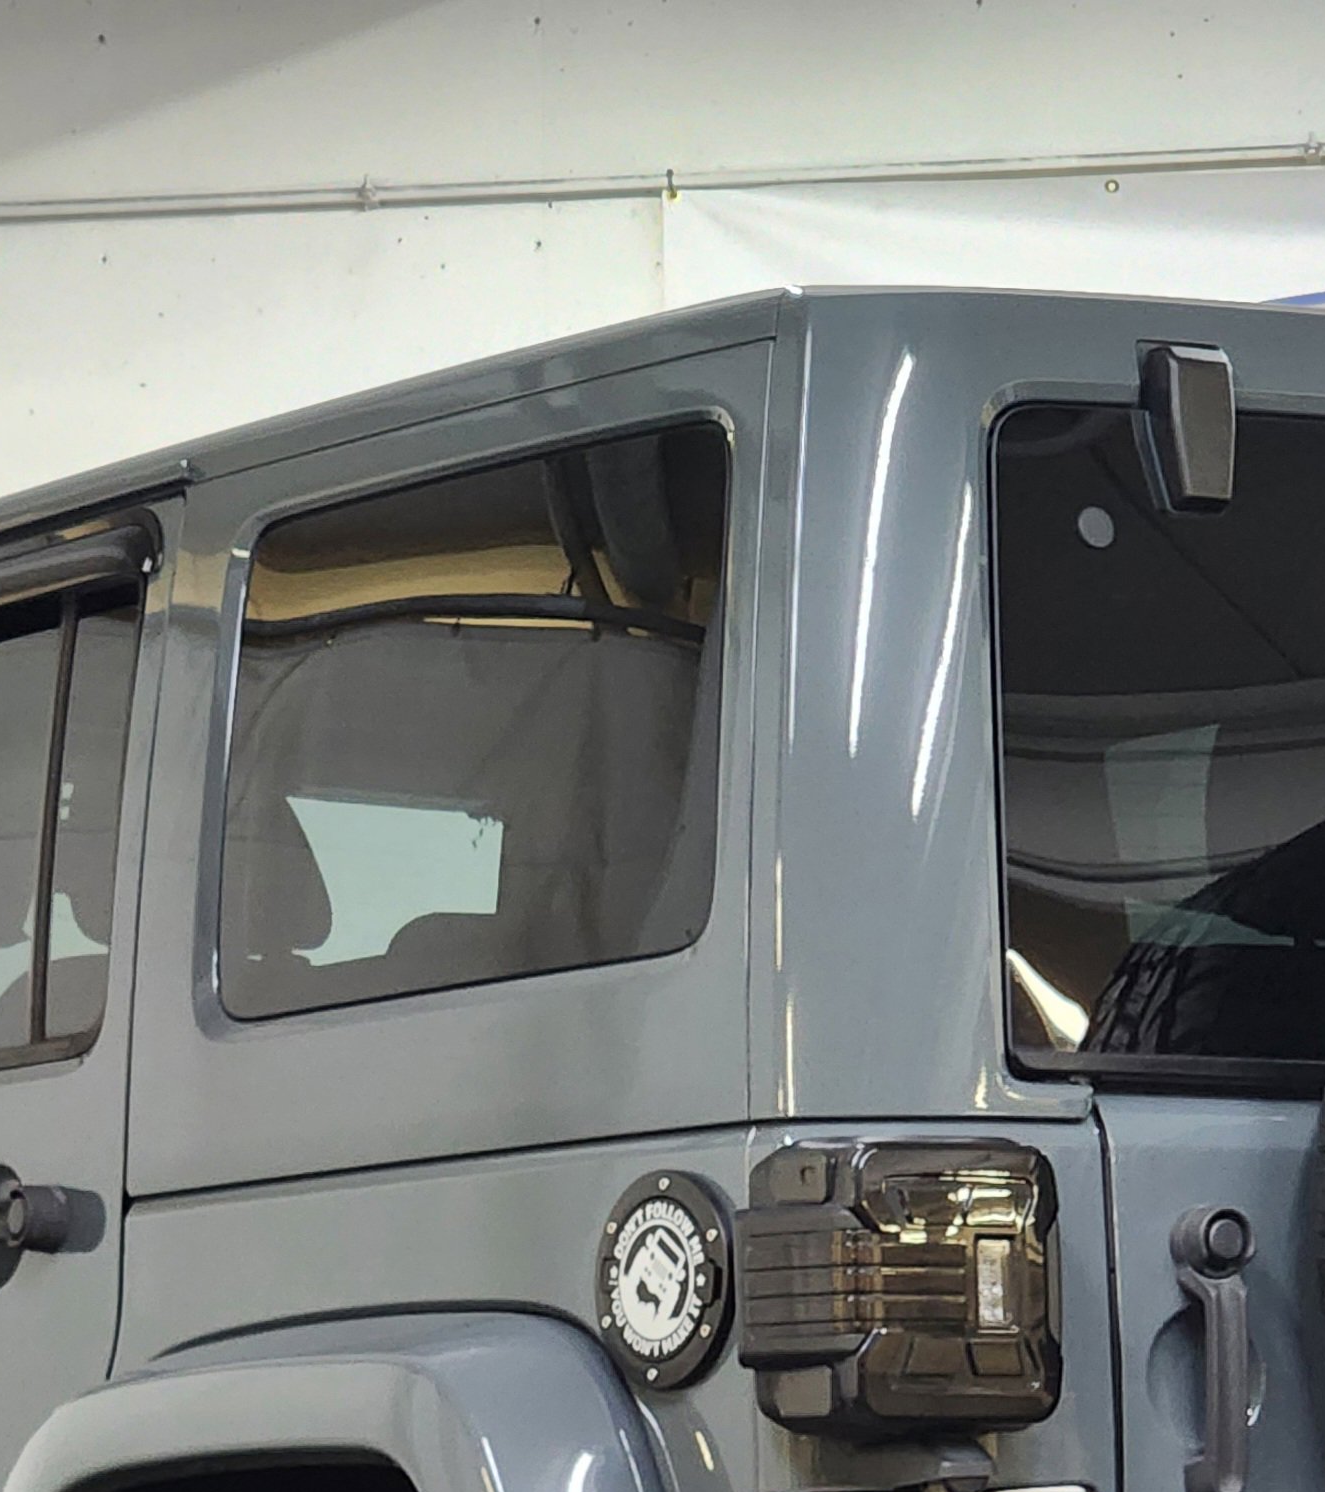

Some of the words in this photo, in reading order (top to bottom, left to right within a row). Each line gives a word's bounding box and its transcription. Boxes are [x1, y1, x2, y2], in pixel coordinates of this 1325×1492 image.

[613, 1208, 644, 1260] DON'T
[646, 1201, 694, 1237] FOLLOW
[689, 1237, 704, 1266] ME
[610, 1287, 626, 1328] YOU
[660, 1319, 695, 1356] MAKE
